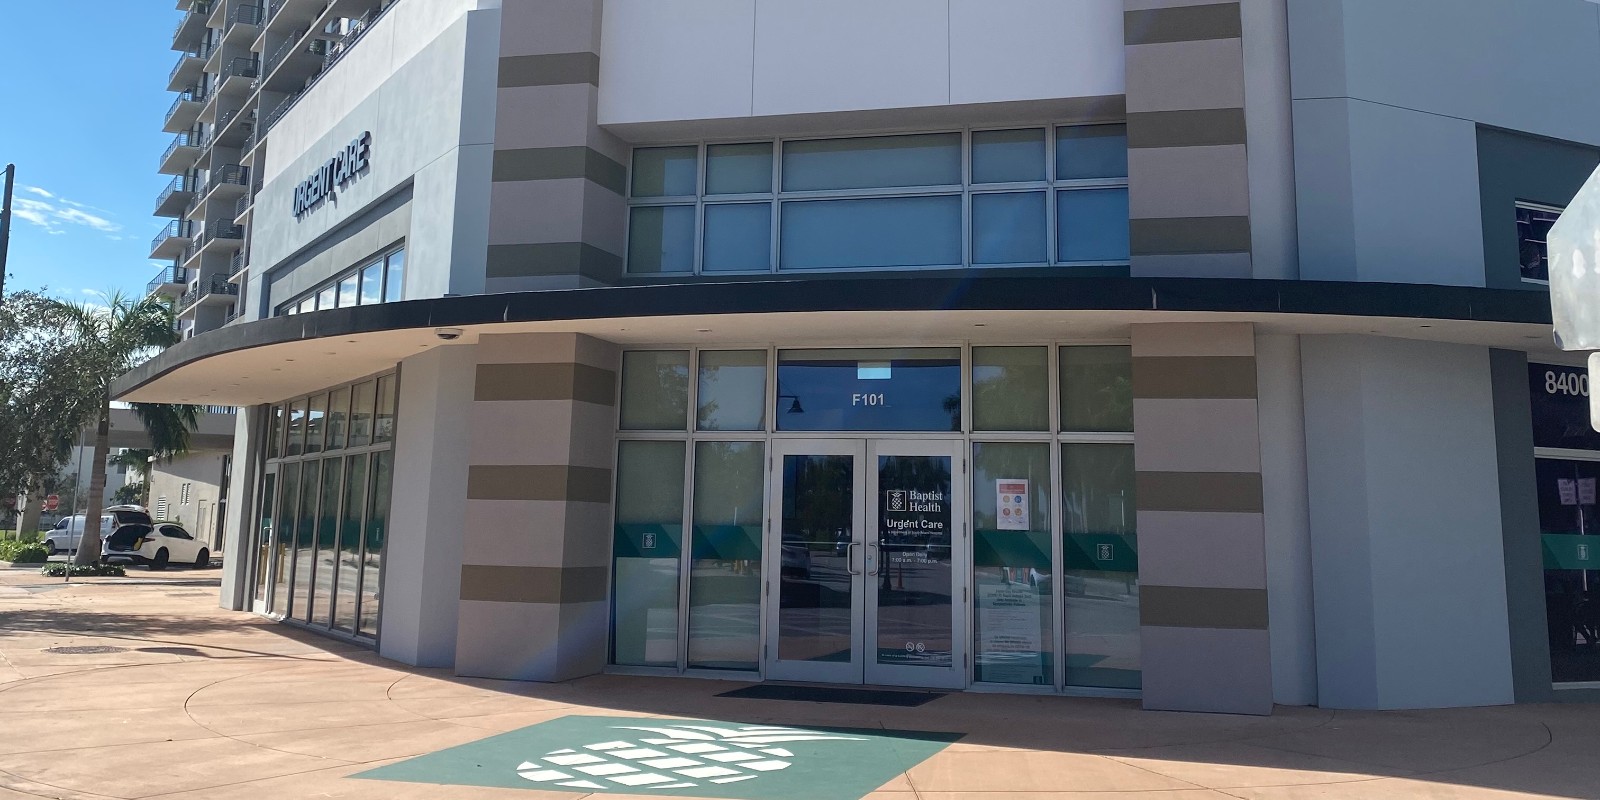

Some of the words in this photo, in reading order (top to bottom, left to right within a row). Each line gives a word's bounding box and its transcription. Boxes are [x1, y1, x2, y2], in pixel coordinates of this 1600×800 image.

[292, 158, 334, 217] URGENT
[333, 131, 369, 187] CARE
[1545, 371, 1590, 397] 8400
[852, 393, 884, 406] F101
[910, 490, 943, 502] Baptist
[909, 502, 941, 512] Health
[887, 519, 918, 529] Urgent
[921, 520, 943, 528] Care
